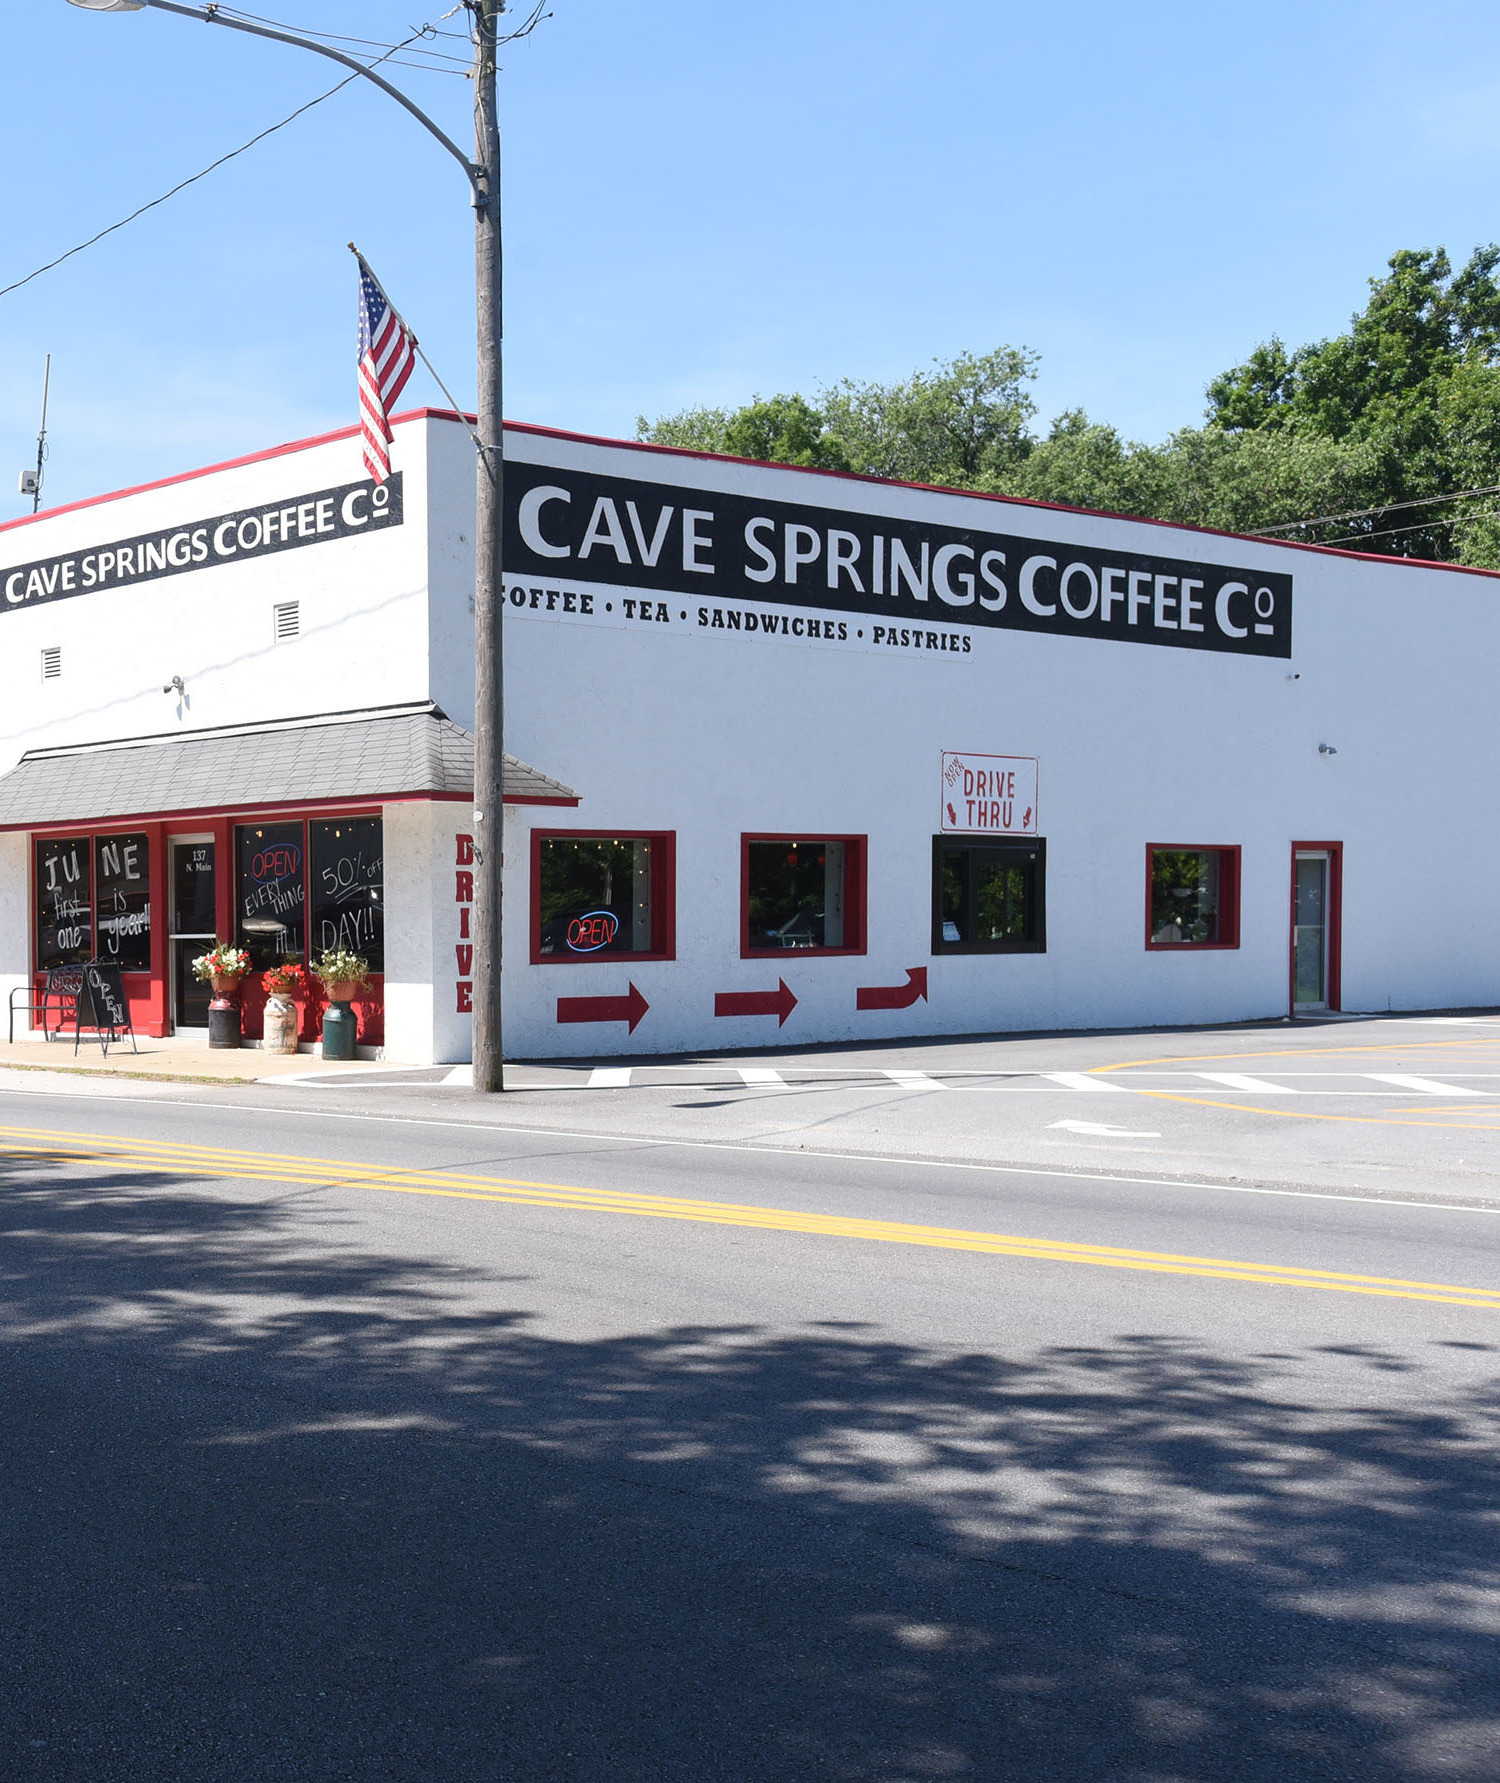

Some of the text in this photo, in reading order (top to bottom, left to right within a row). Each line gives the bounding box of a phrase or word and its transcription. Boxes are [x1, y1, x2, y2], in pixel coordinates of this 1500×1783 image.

[5, 560, 76, 603] CAVE
[81, 528, 209, 587] SPRINGS
[213, 497, 335, 556] COFFEE
[518, 485, 715, 574] CAVE
[744, 517, 1007, 612] SPRINGS
[1018, 555, 1204, 633] COFFEE
[502, 585, 972, 653] OFFEE TEA SANDWICHES PASTRIES
[944, 756, 961, 781] NOW
[947, 763, 966, 788] OPEN
[963, 769, 1015, 799] DRIVE
[966, 800, 1012, 828] THRU
[193, 850, 206, 861] 137
[195, 862, 212, 871] Main
[252, 850, 297, 878] OPEN
[322, 851, 383, 895] 50% OFF
[54, 888, 127, 921] first is
[245, 877, 305, 917] EVERY THING
[57, 926, 82, 949] one
[322, 906, 375, 953] DAY!!
[455, 833, 474, 1013] DRIVE
[567, 919, 615, 945] OPEN
[89, 967, 124, 1024] OPEN
